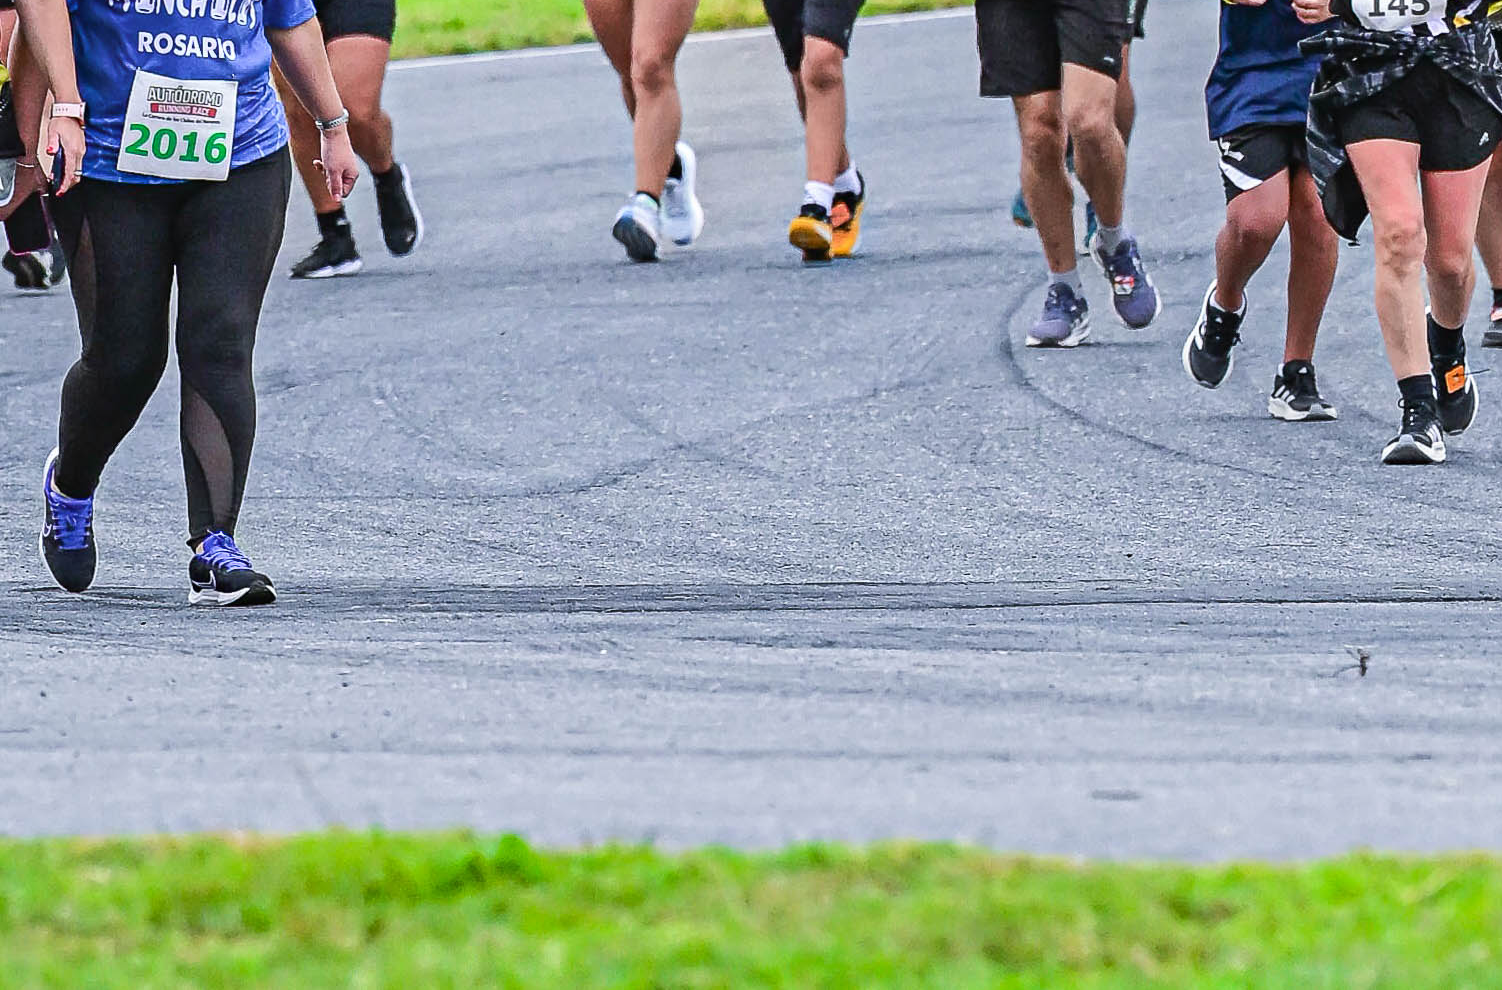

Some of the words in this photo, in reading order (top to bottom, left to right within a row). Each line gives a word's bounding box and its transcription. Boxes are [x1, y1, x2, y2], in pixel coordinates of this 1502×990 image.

[138, 31, 236, 60] ROSARIO
[147, 85, 224, 107] AUTÓDROMO
[124, 123, 227, 164] 2016
